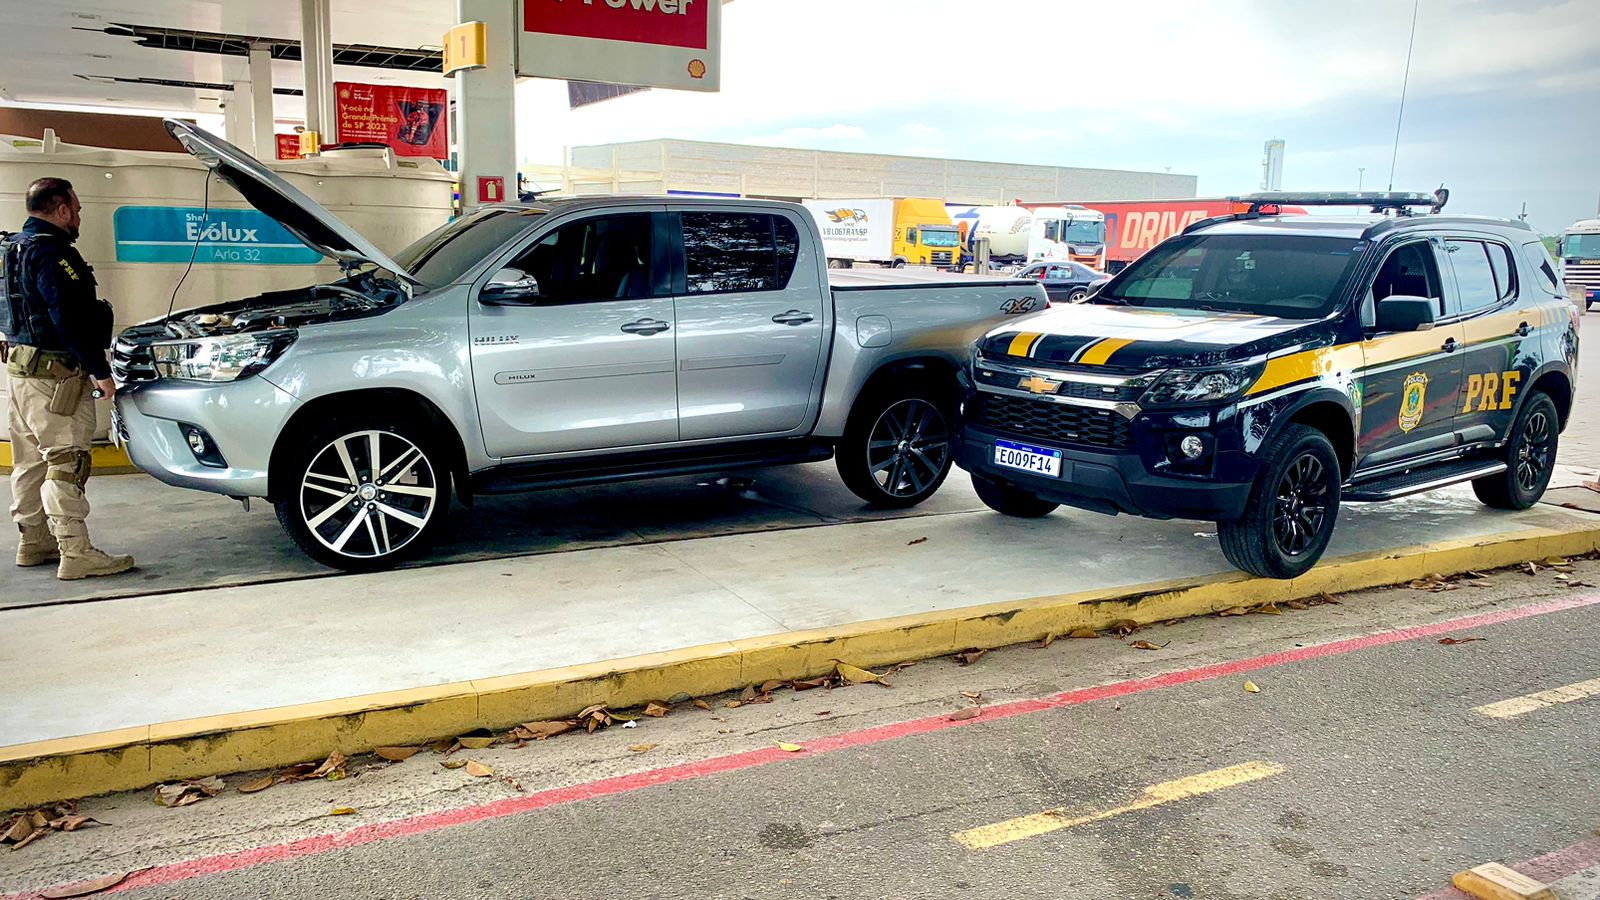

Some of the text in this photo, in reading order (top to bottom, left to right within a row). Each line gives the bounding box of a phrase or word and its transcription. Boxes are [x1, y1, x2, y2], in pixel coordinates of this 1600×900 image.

[186, 221, 259, 242] Evolux
[1120, 210, 1208, 249] DRIV
[213, 248, 262, 261] Arla 32
[1462, 370, 1520, 413] PRF
